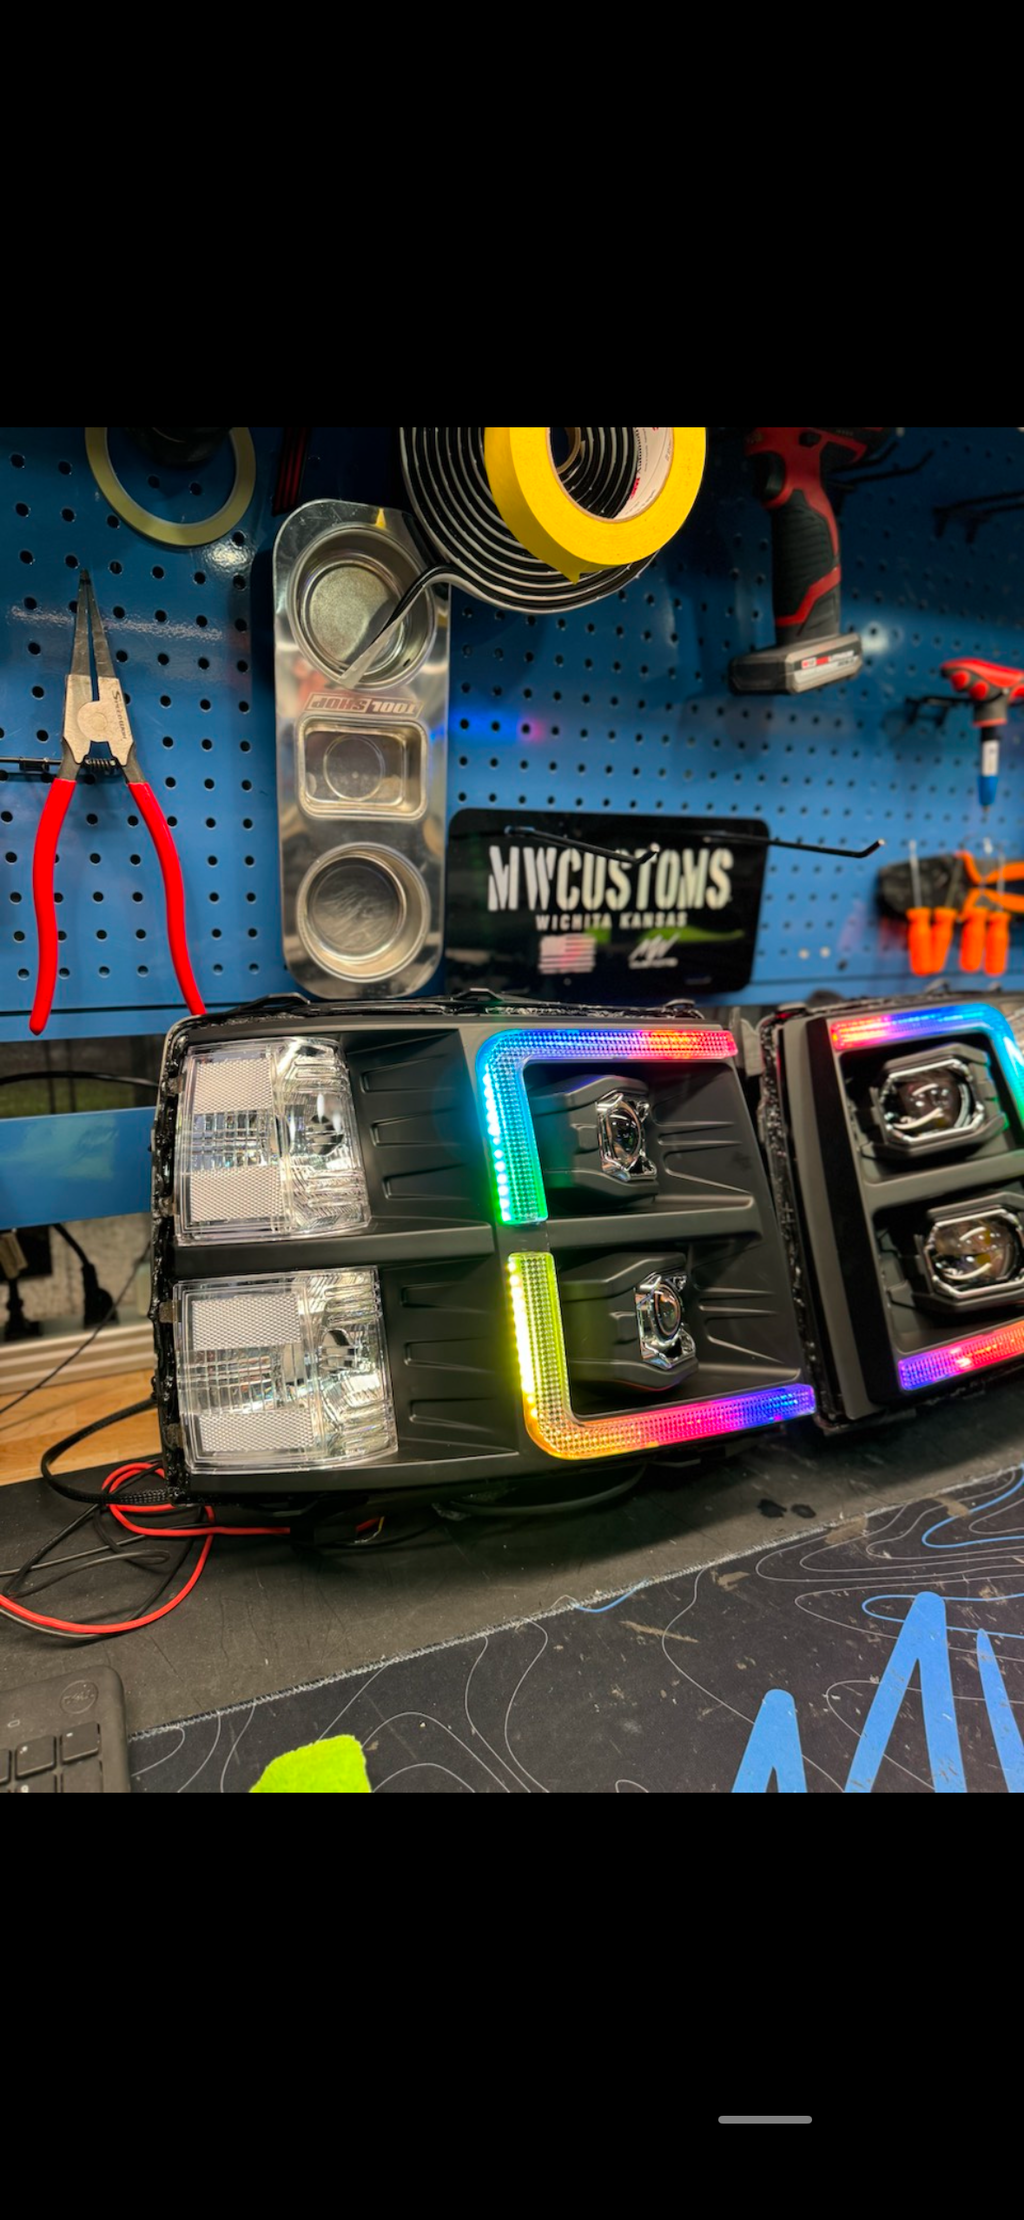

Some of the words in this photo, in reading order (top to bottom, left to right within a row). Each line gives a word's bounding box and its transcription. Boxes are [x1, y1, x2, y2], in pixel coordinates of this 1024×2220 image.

[311, 697, 368, 711] SHOP
[371, 701, 416, 714] TOOL
[488, 845, 734, 911] MWCUSTOMS
[536, 913, 612, 931] WICHITA
[619, 911, 688, 929] KANSAS
